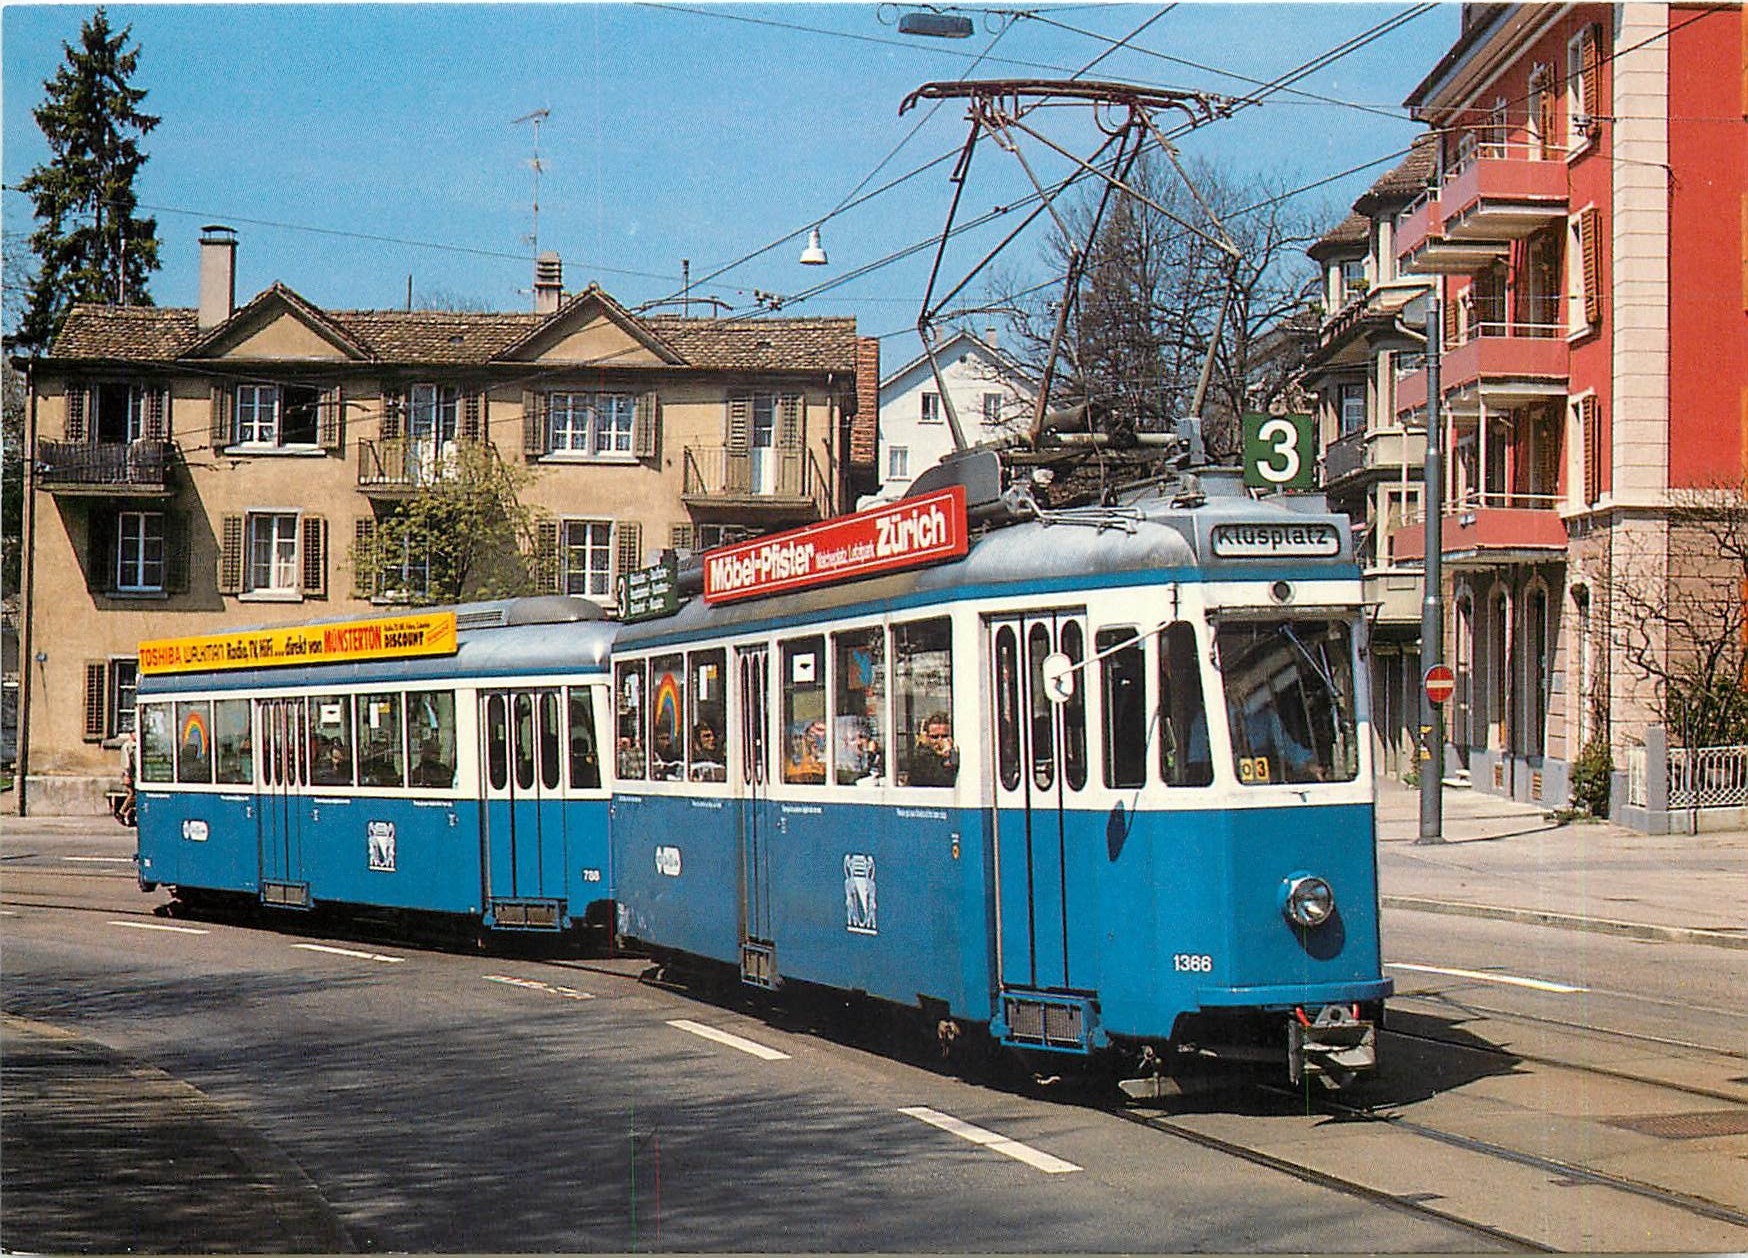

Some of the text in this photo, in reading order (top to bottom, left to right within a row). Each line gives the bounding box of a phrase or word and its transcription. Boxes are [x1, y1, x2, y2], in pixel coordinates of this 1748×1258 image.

[1256, 419, 1300, 482] 3
[709, 542, 815, 593] Möbel-Pfister
[875, 505, 946, 557] Zürich
[1218, 527, 1328, 550] Klusplatz
[618, 577, 626, 618] 3
[384, 631, 424, 648] DISCOUNT
[140, 646, 181, 666] TOSHIBA
[1174, 954, 1212, 972] 1366
